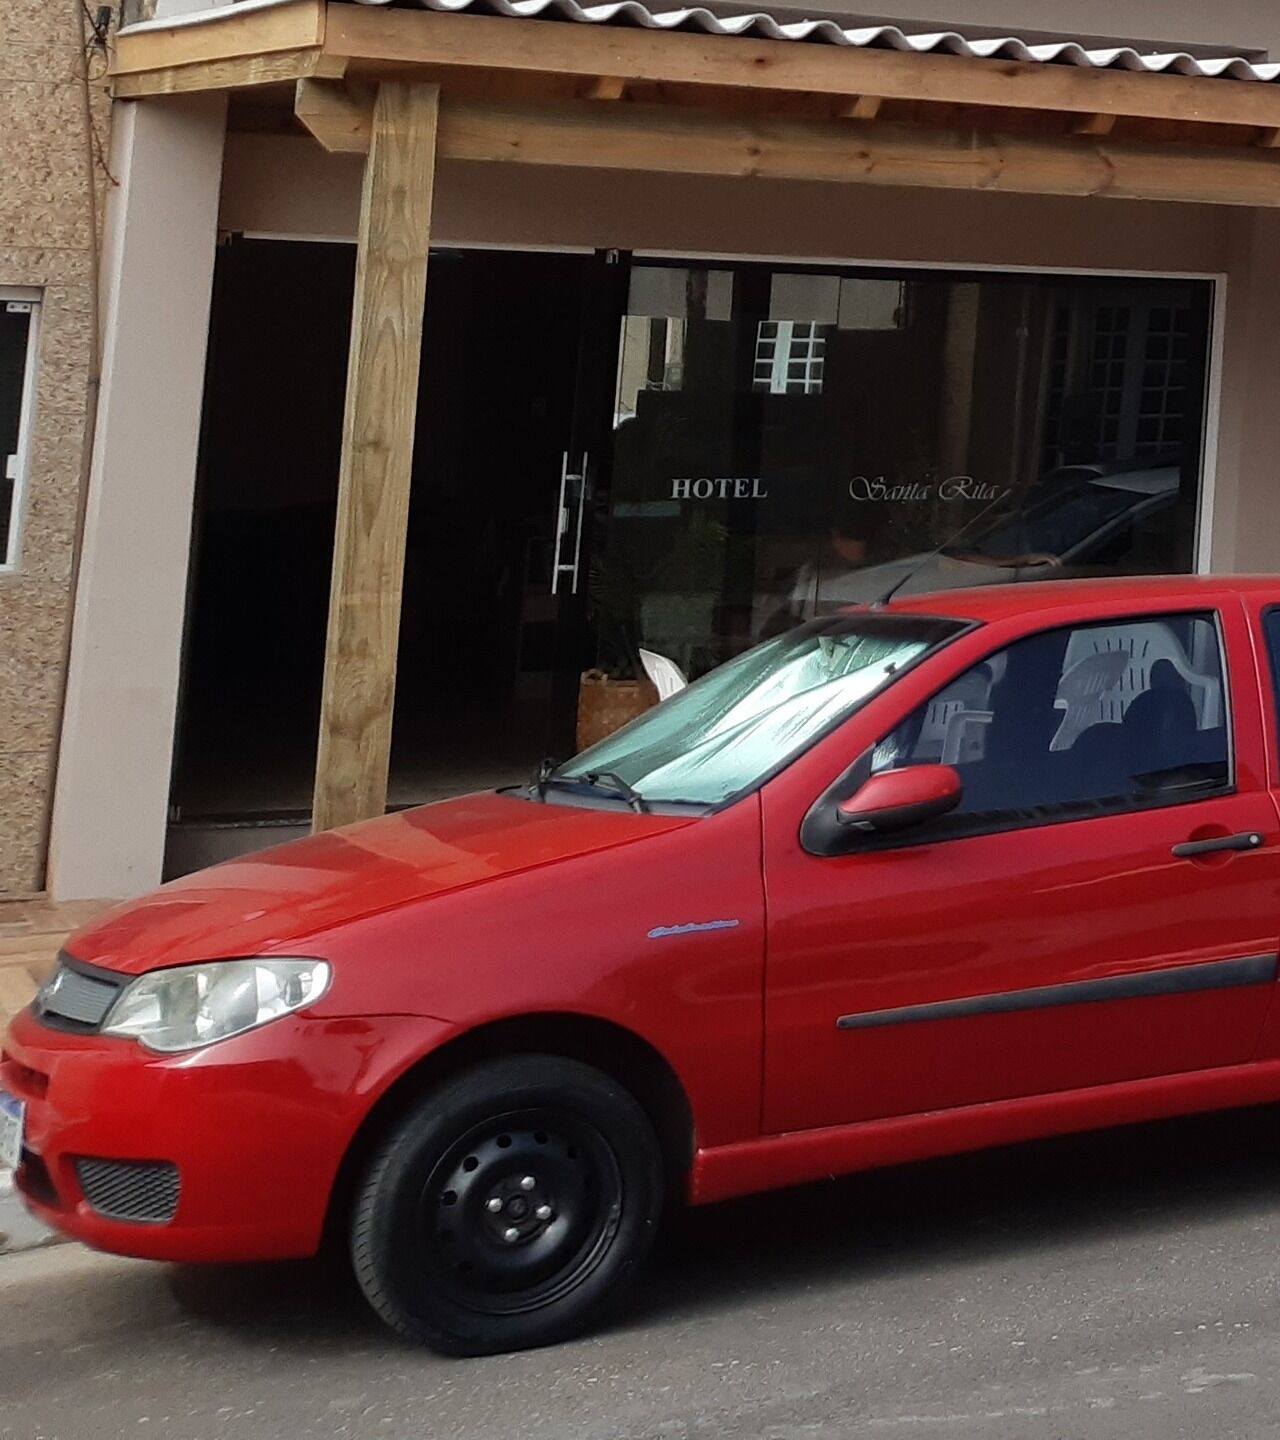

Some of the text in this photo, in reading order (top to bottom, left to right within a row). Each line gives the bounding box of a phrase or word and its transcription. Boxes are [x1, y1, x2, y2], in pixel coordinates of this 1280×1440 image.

[671, 475, 999, 501] HOTEL Santa Rita
